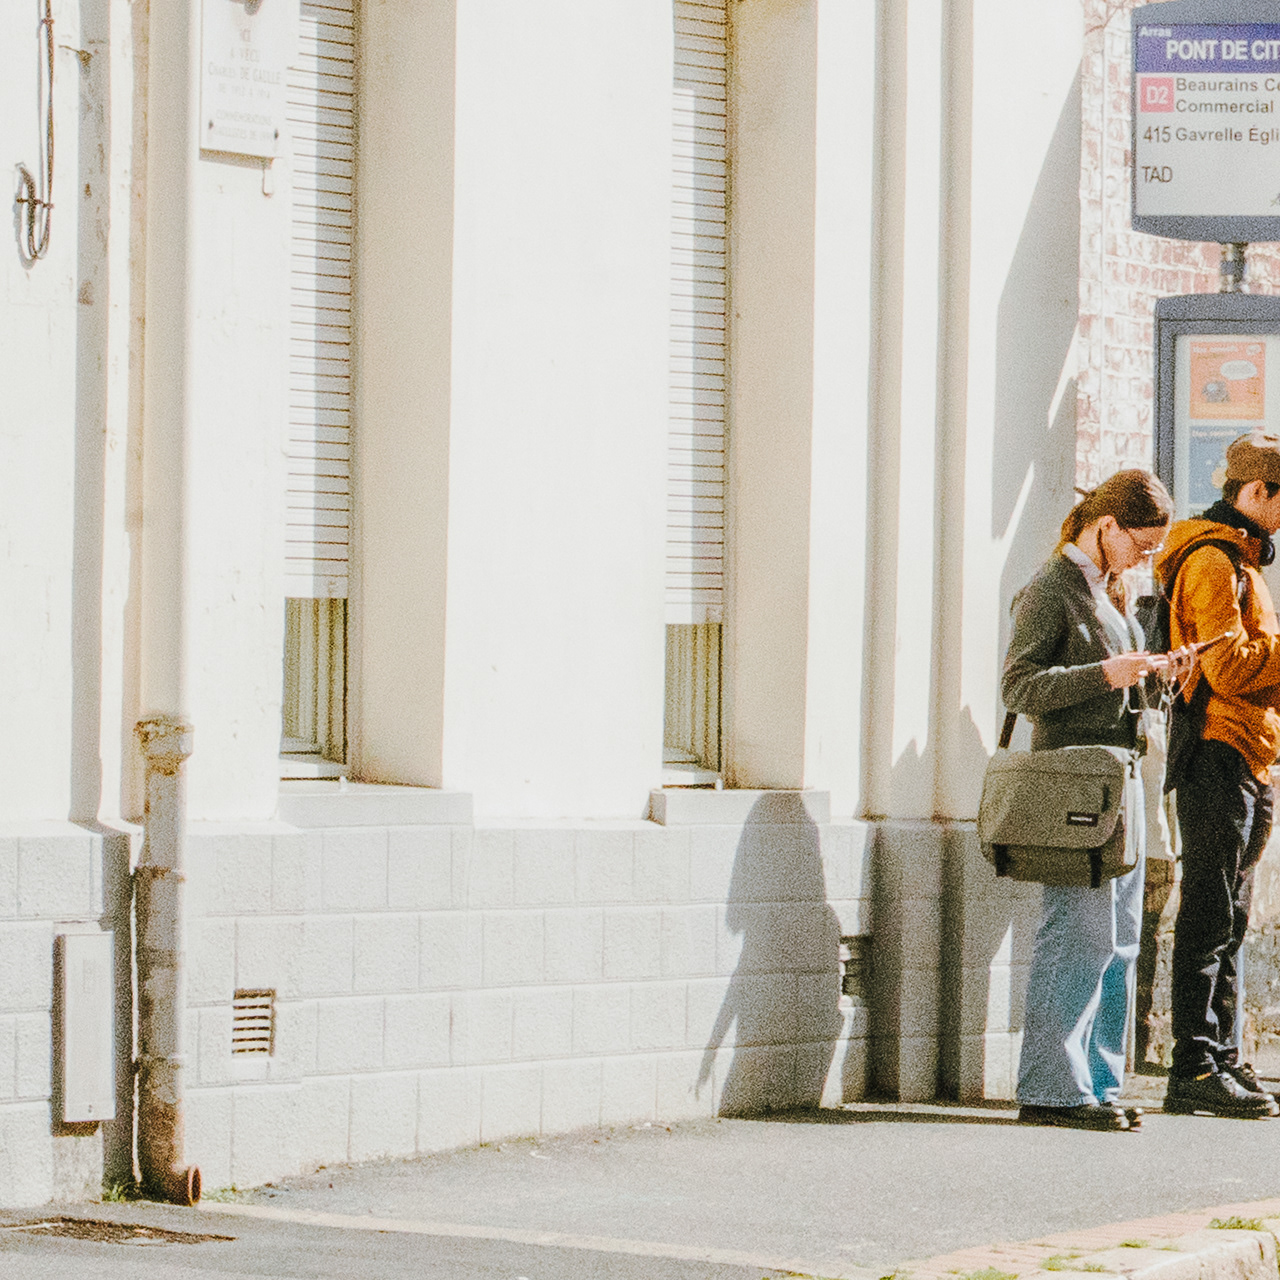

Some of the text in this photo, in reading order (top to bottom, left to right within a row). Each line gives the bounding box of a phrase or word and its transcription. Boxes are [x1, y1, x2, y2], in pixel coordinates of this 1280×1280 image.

[1140, 26, 1172, 37] Arras
[1166, 40, 1218, 60] PONT
[1222, 40, 1249, 60] DE
[252, 68, 281, 85] GAULLE
[1176, 78, 1258, 92] Beaurains
[1147, 86, 1169, 105] D2
[1176, 99, 1274, 114] Commercial
[1143, 126, 1171, 143] 415
[1176, 127, 1243, 142] Gavrelle
[1141, 166, 1173, 183] TAD
